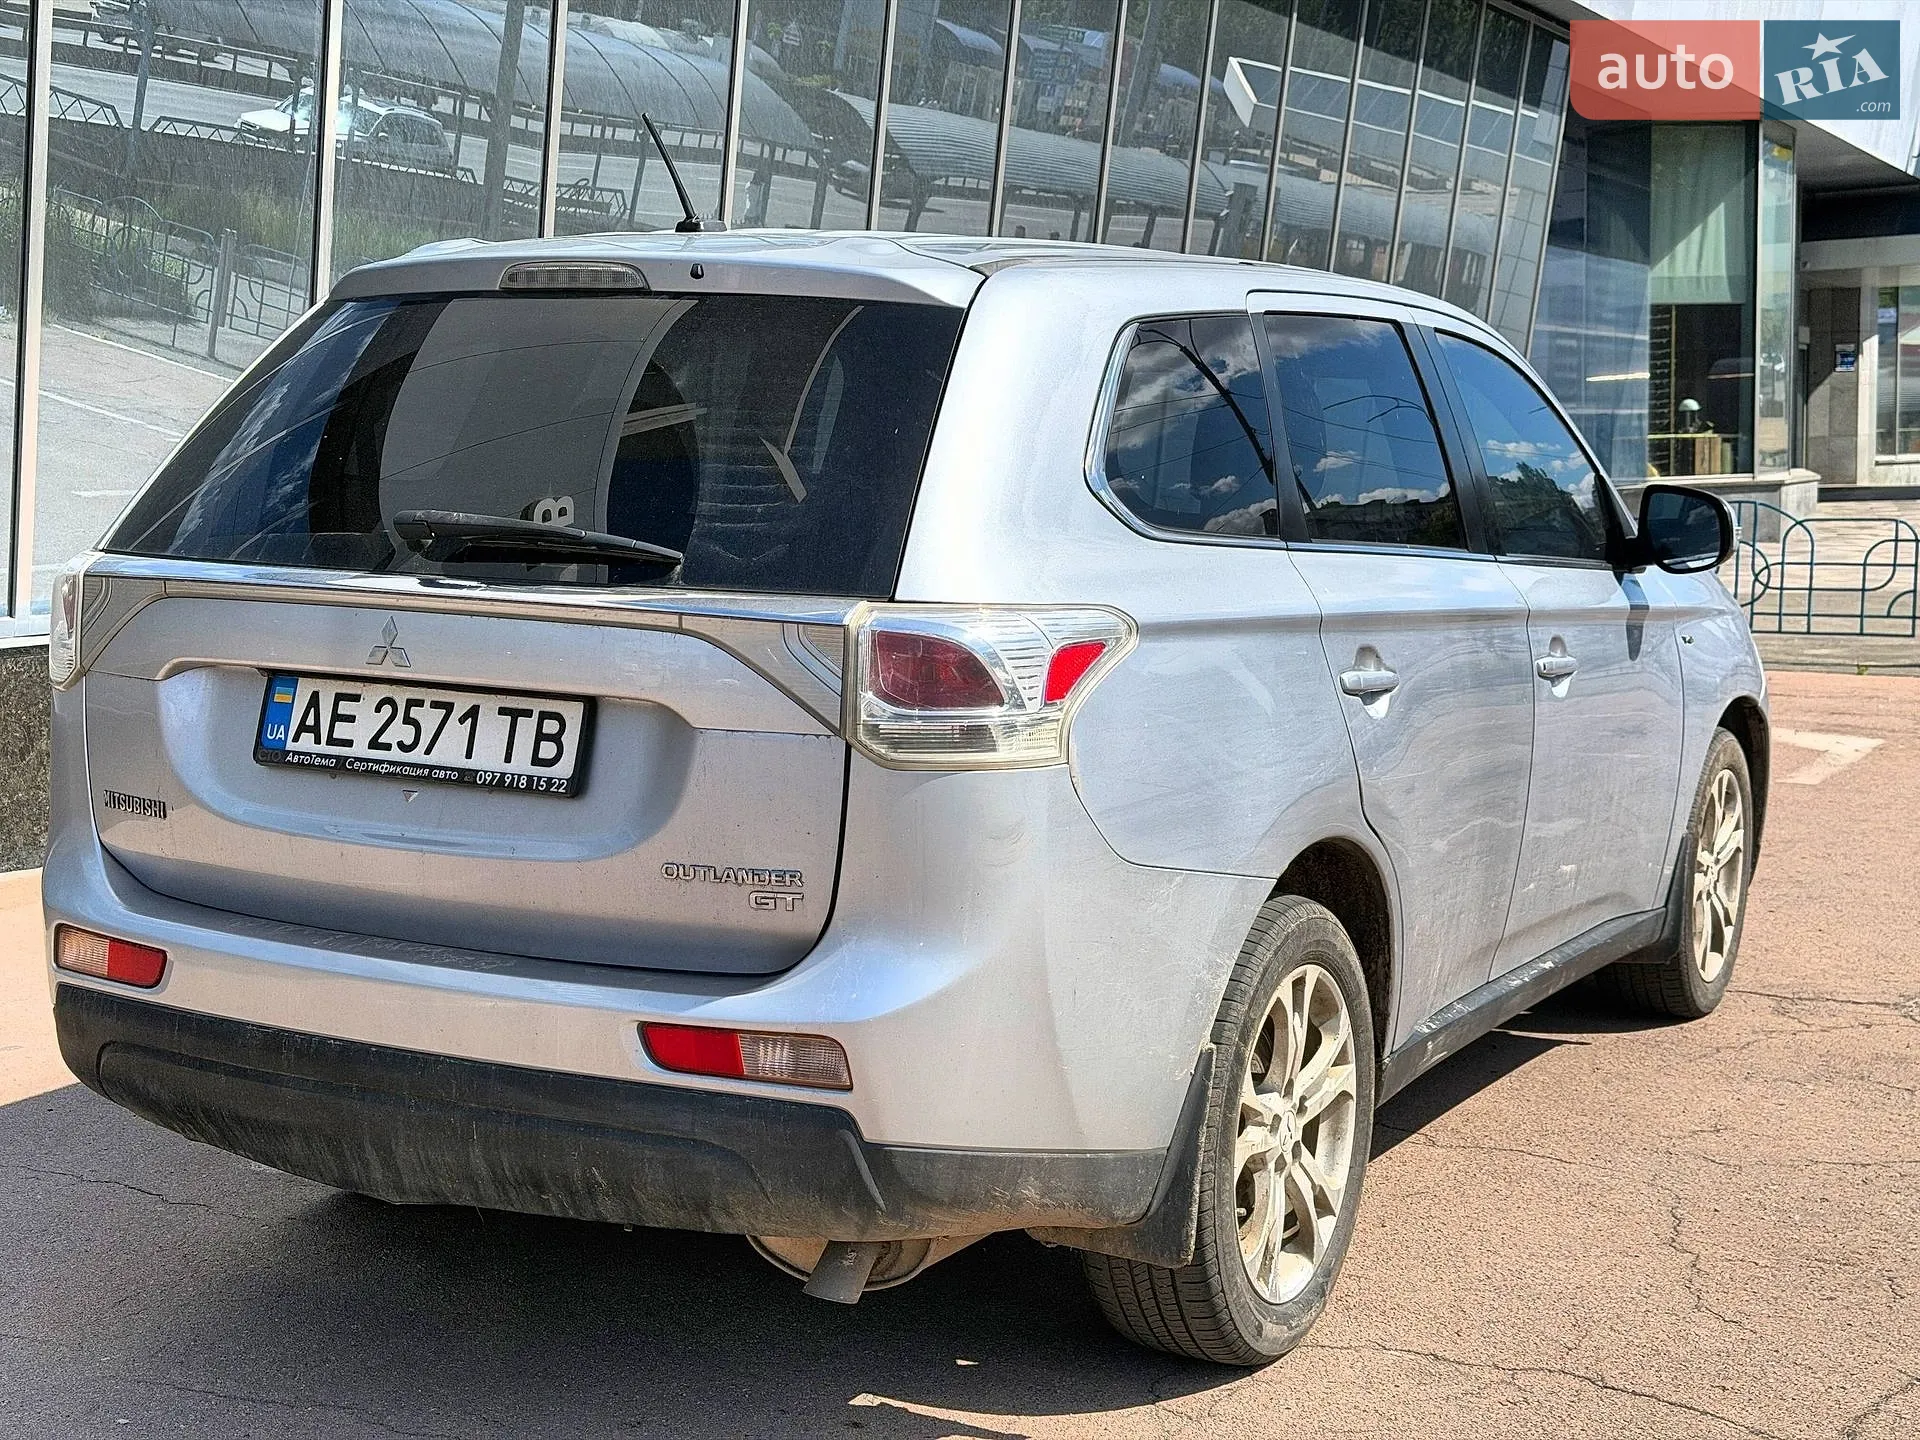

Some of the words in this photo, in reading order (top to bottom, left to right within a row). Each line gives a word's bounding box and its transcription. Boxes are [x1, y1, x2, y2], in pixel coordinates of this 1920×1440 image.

[267, 724, 285, 741] UA
[291, 690, 363, 748] AE
[367, 696, 481, 760] 2571
[497, 706, 569, 768] TB
[285, 752, 336, 767] АвтоТема
[345, 758, 430, 776] Сертификация
[431, 769, 459, 780] авто
[476, 771, 500, 785] 097
[504, 774, 527, 789] 918
[532, 776, 548, 791] 15
[549, 779, 568, 793] 22
[103, 789, 167, 820] MITSUBISHI
[660, 862, 804, 887] OUTLANDER
[749, 890, 805, 911] GT
